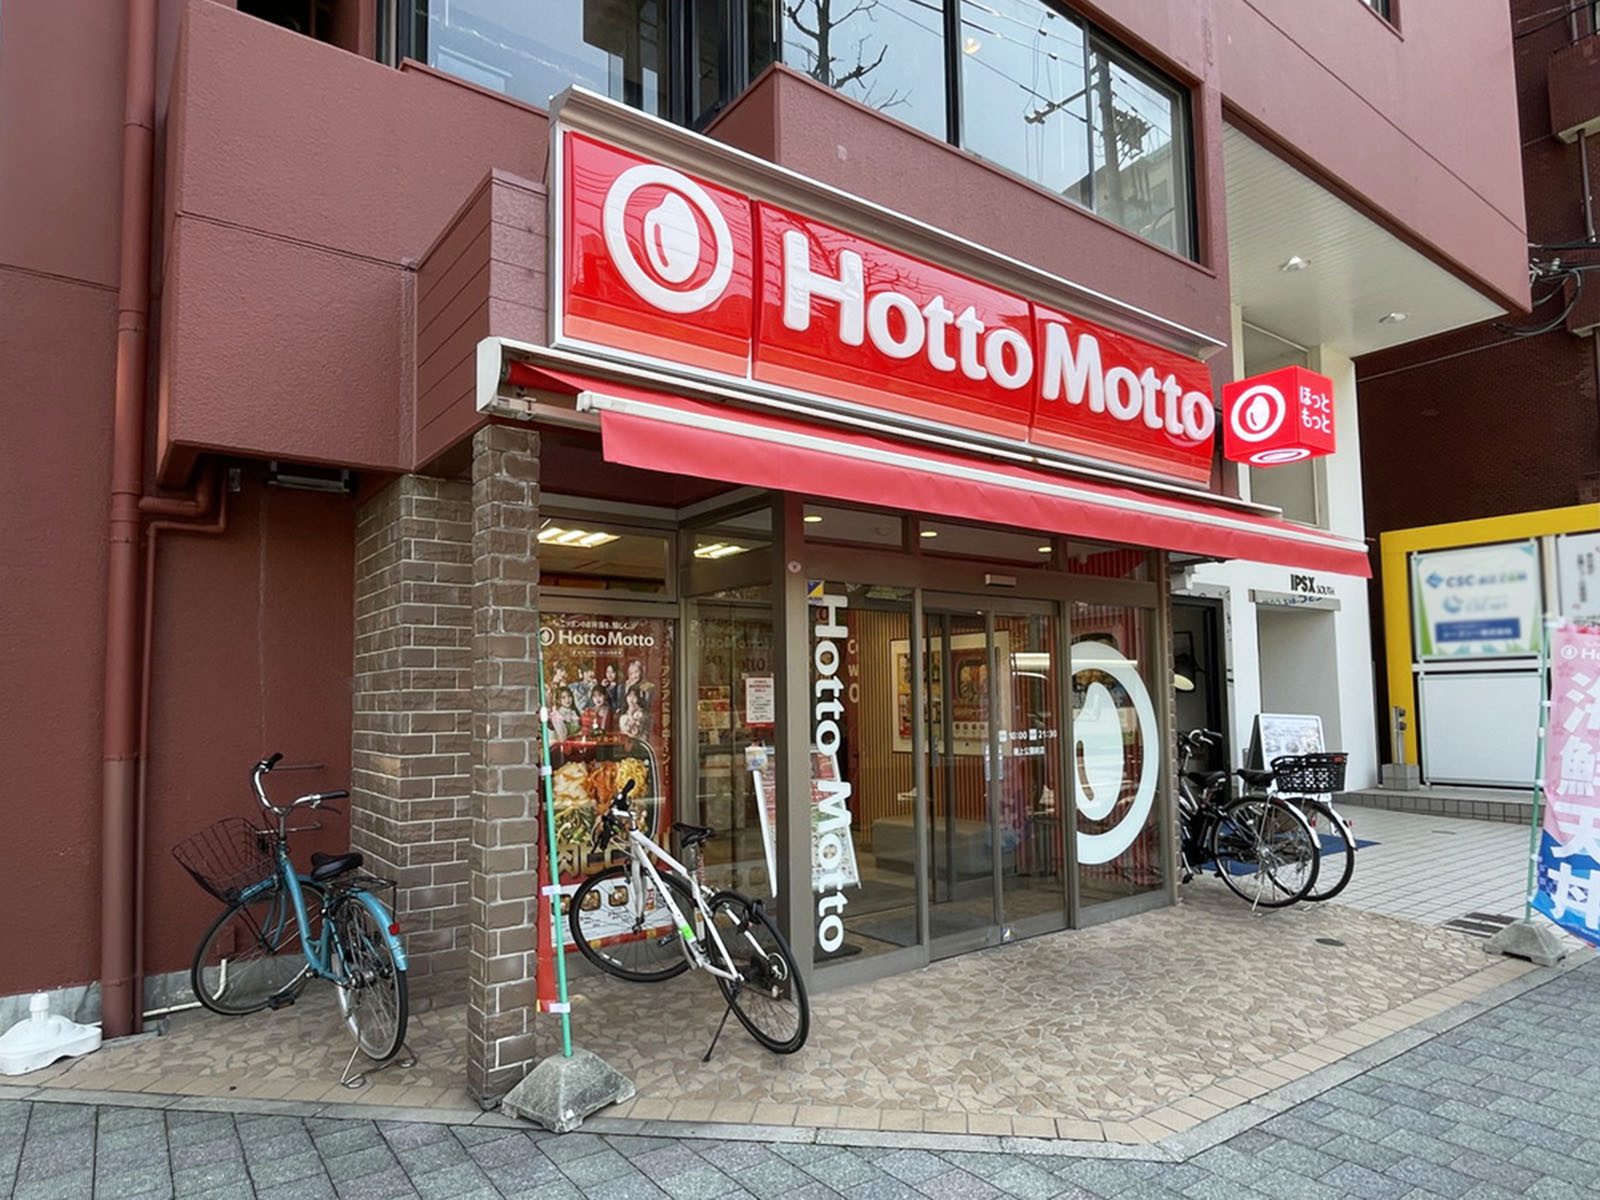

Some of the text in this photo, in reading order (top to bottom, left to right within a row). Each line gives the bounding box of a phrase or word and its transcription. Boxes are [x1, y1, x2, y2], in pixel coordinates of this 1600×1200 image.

[782, 229, 1216, 441] Hotto Motto
[1299, 385, 1331, 413] ほっと
[1300, 407, 1332, 434] もっと
[1290, 573, 1316, 594] IPSX
[558, 629, 655, 647] Hotto Motto
[809, 594, 849, 757] Hotto
[817, 780, 852, 953] Motto
